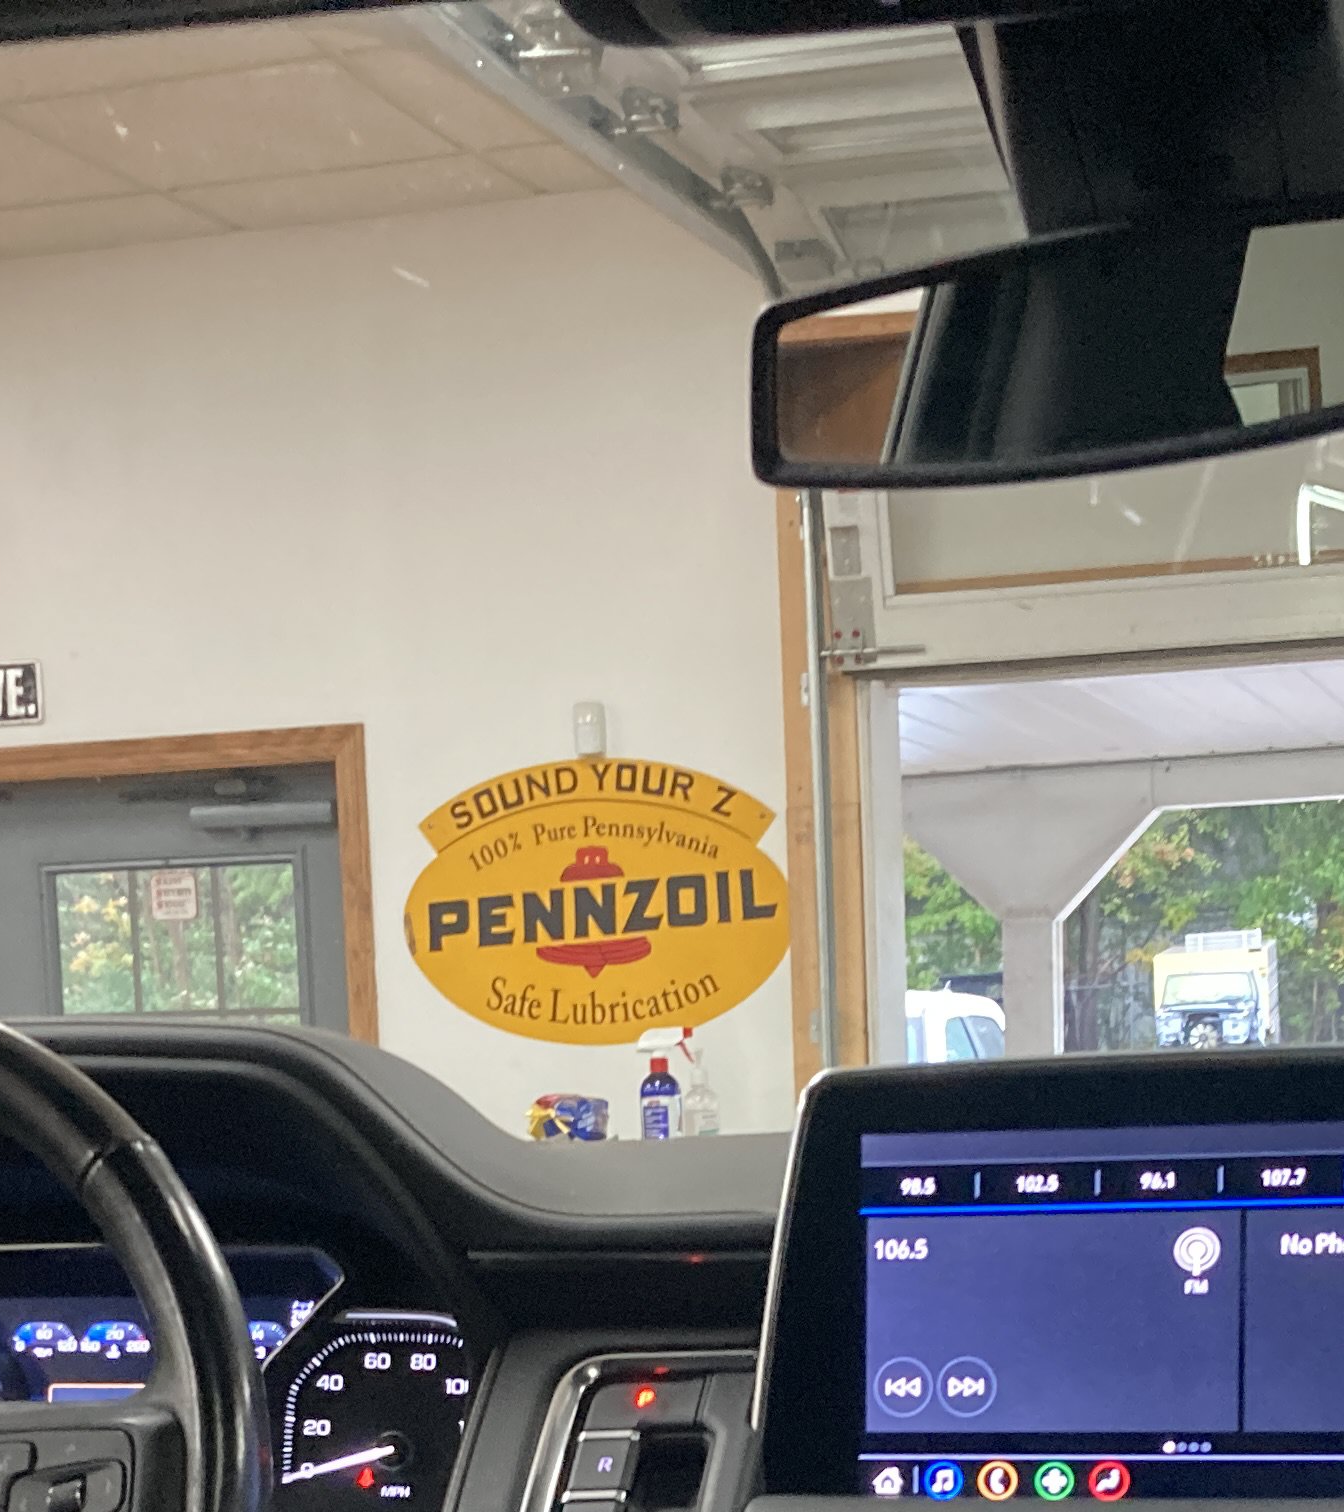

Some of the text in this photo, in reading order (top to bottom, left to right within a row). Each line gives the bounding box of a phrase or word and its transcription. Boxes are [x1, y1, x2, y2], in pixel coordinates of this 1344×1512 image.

[450, 763, 738, 830] SOUND YOUR Z
[468, 815, 720, 872] 100% Pure Pennsylvania
[428, 868, 778, 953] PENNZOIL
[486, 973, 721, 1025] Safe Lubrication
[1016, 1173, 1060, 1194] 102.5
[1139, 1170, 1177, 1191] 96.1
[1260, 1166, 1307, 1188] 107.7
[873, 1238, 929, 1261] 106.5
[1280, 1232, 1313, 1256] No
[1183, 1278, 1209, 1295] FM
[364, 1352, 391, 1370] 60
[410, 1352, 437, 1371] 80
[316, 1374, 344, 1392] 40
[303, 1418, 332, 1437] 20
[597, 1456, 614, 1473] R
